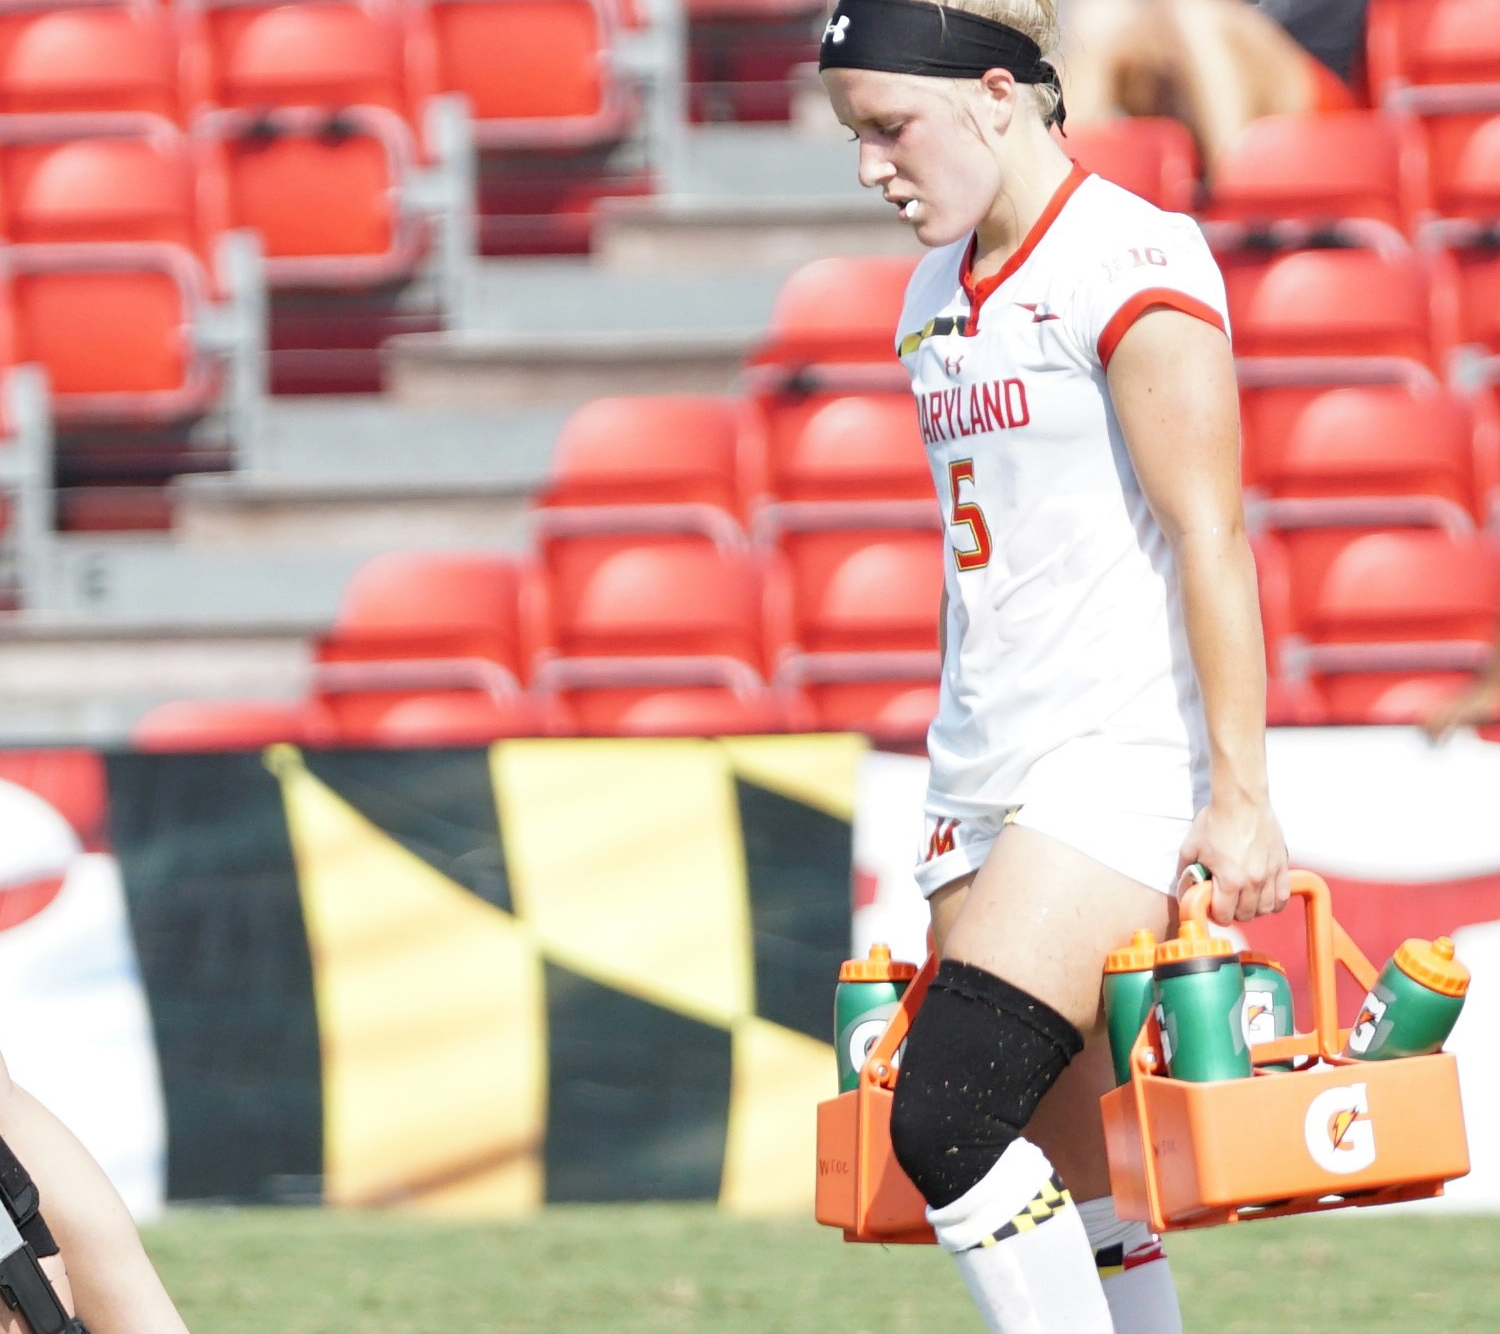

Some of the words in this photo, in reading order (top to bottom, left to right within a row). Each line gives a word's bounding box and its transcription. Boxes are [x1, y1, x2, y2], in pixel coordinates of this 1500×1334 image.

[915, 377, 1031, 445] ARYLAND
[948, 457, 992, 572] 5
[1304, 1082, 1377, 1175] G
